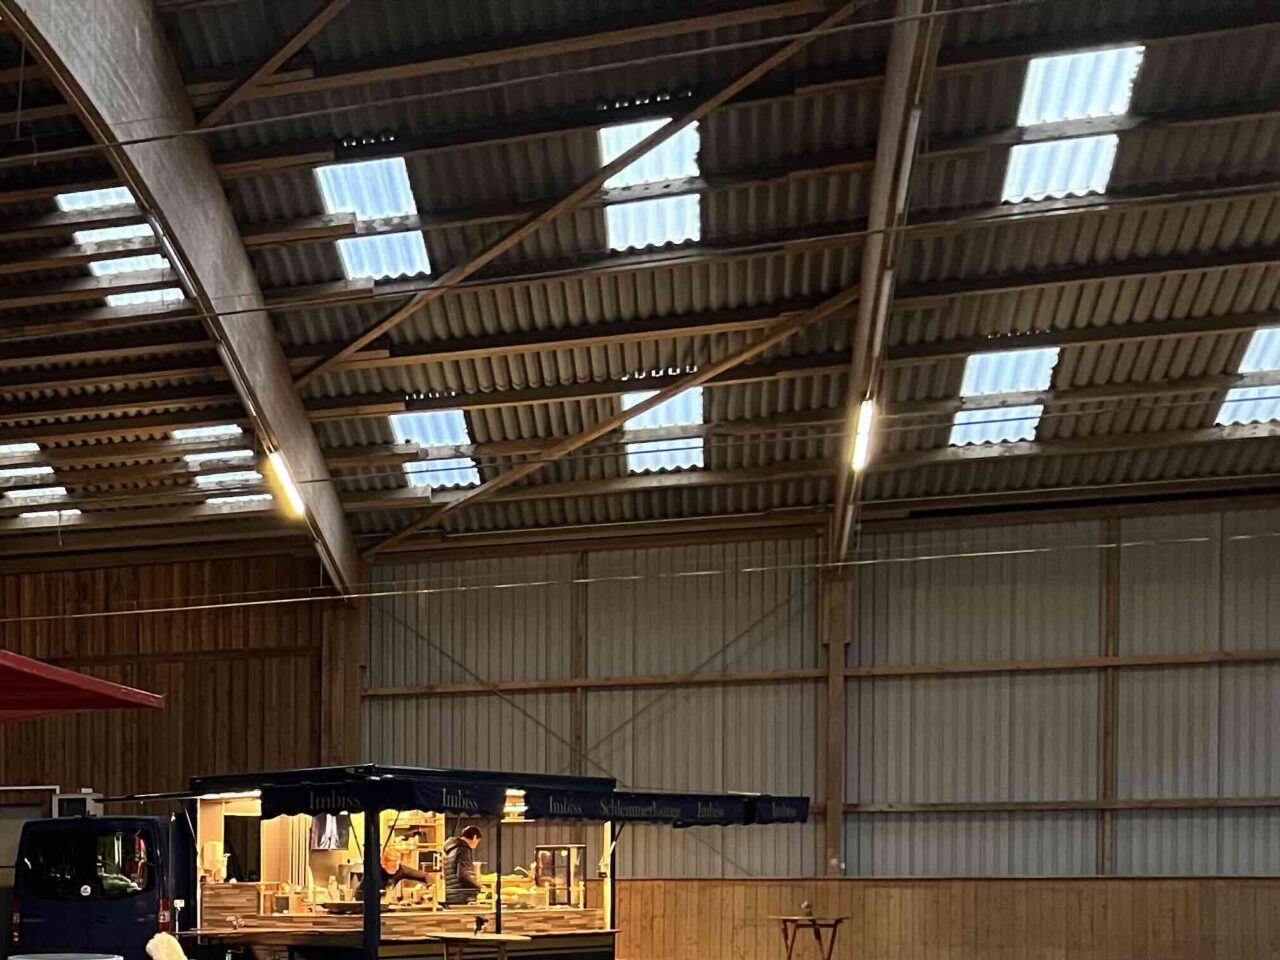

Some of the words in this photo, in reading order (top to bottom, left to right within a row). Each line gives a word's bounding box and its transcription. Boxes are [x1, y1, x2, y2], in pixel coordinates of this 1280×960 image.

[309, 789, 361, 810] Imbiss
[442, 787, 479, 809] Imbiss
[548, 795, 582, 814] Imbiss
